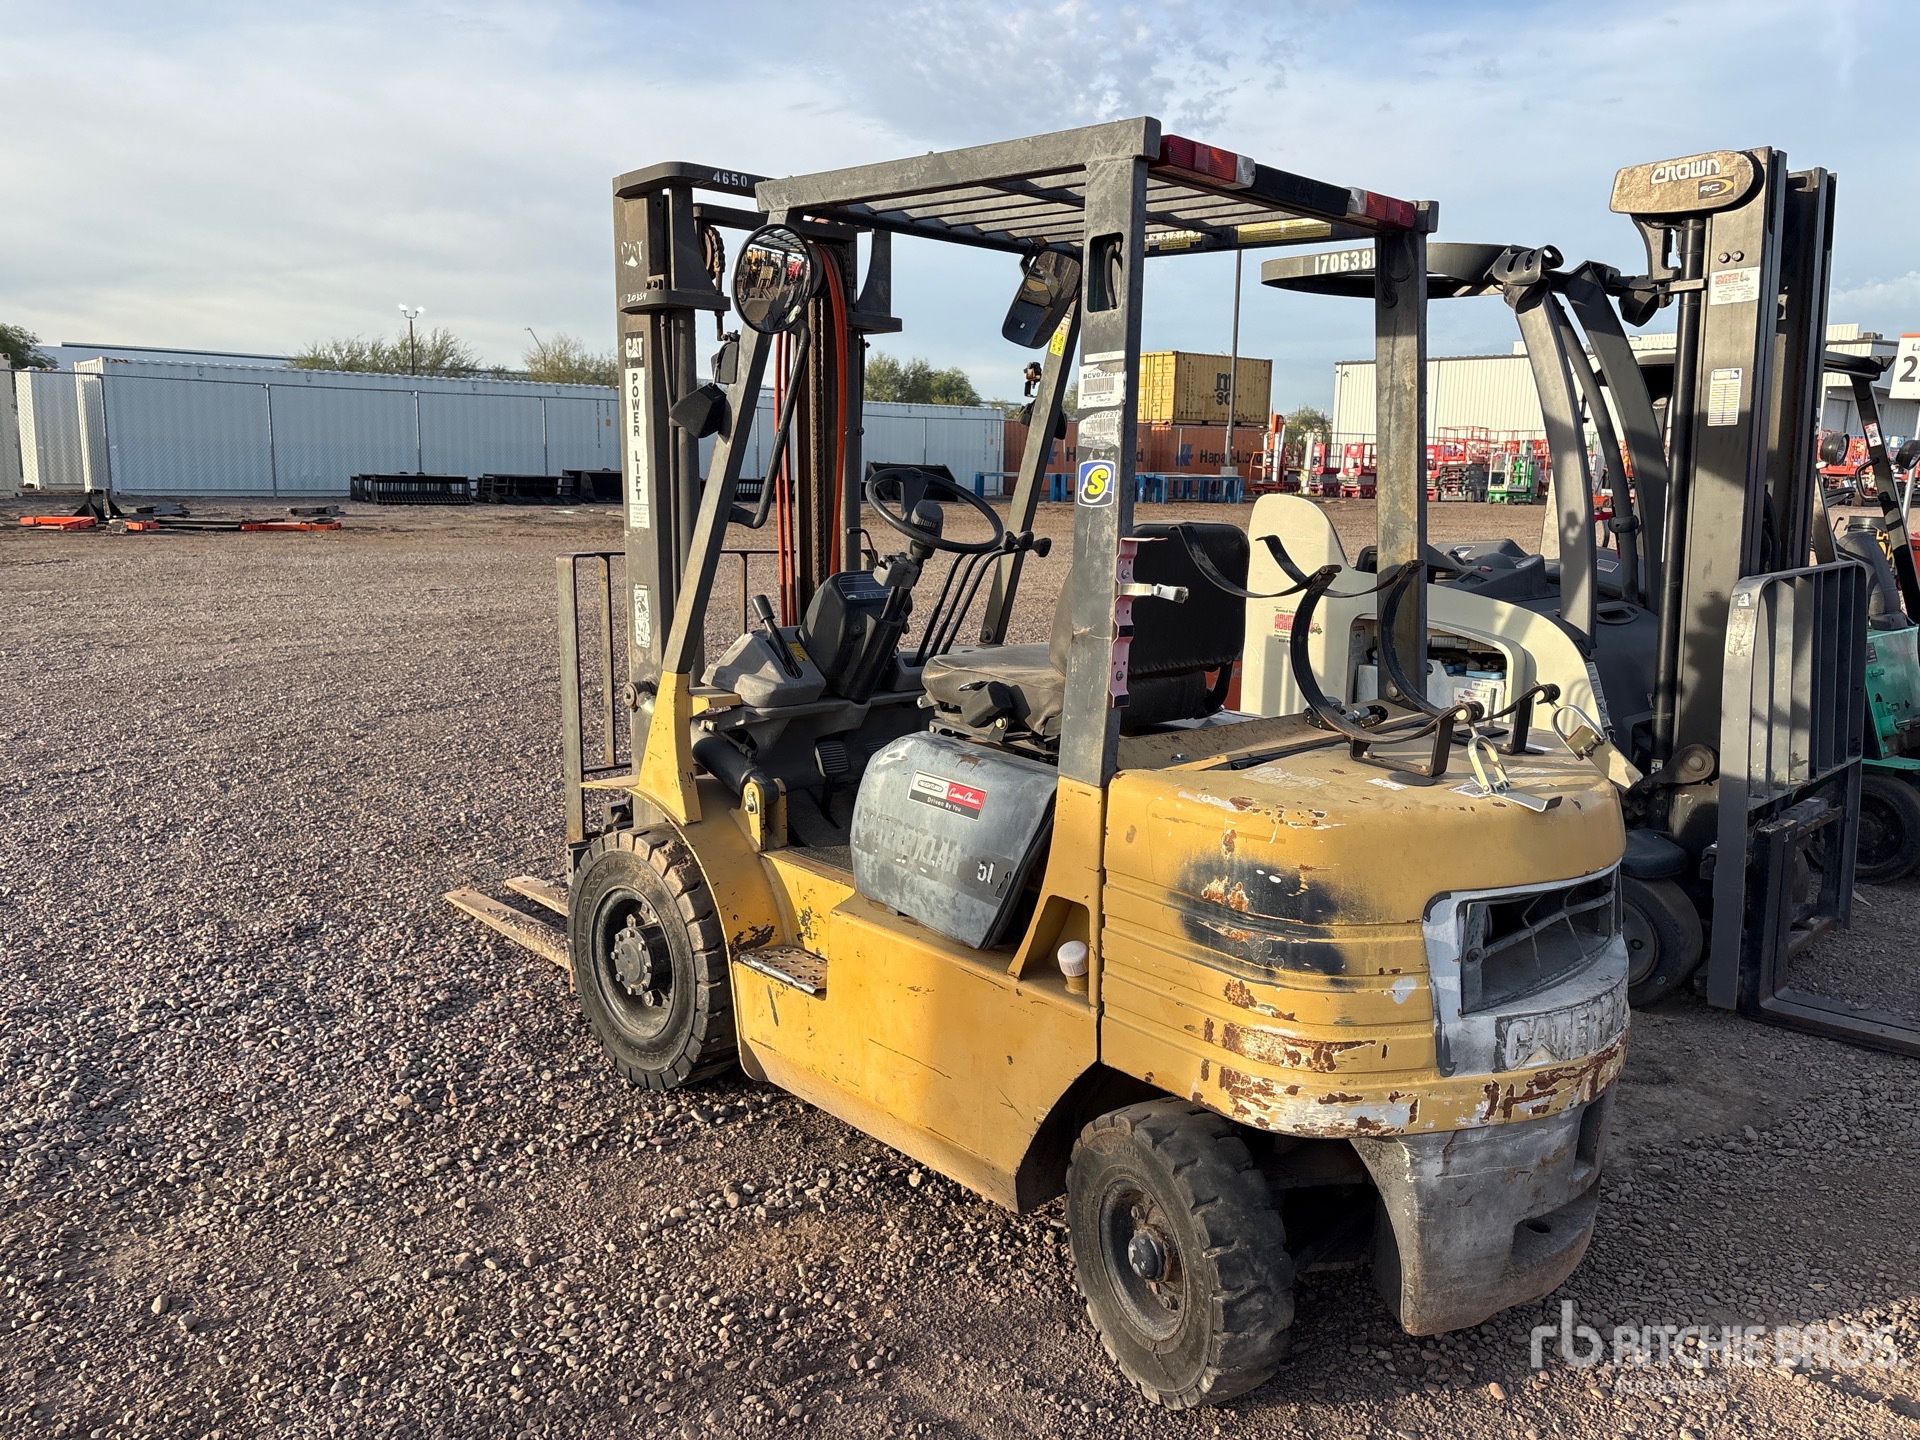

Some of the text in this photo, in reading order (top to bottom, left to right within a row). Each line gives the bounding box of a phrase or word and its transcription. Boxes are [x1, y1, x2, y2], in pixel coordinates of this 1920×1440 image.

[712, 170, 748, 188] 4650
[1651, 158, 1720, 184] CROWN
[625, 337, 644, 359] CAT
[630, 372, 641, 438] POWER
[634, 450, 642, 501] LIFT
[927, 796, 962, 812] Driven By You
